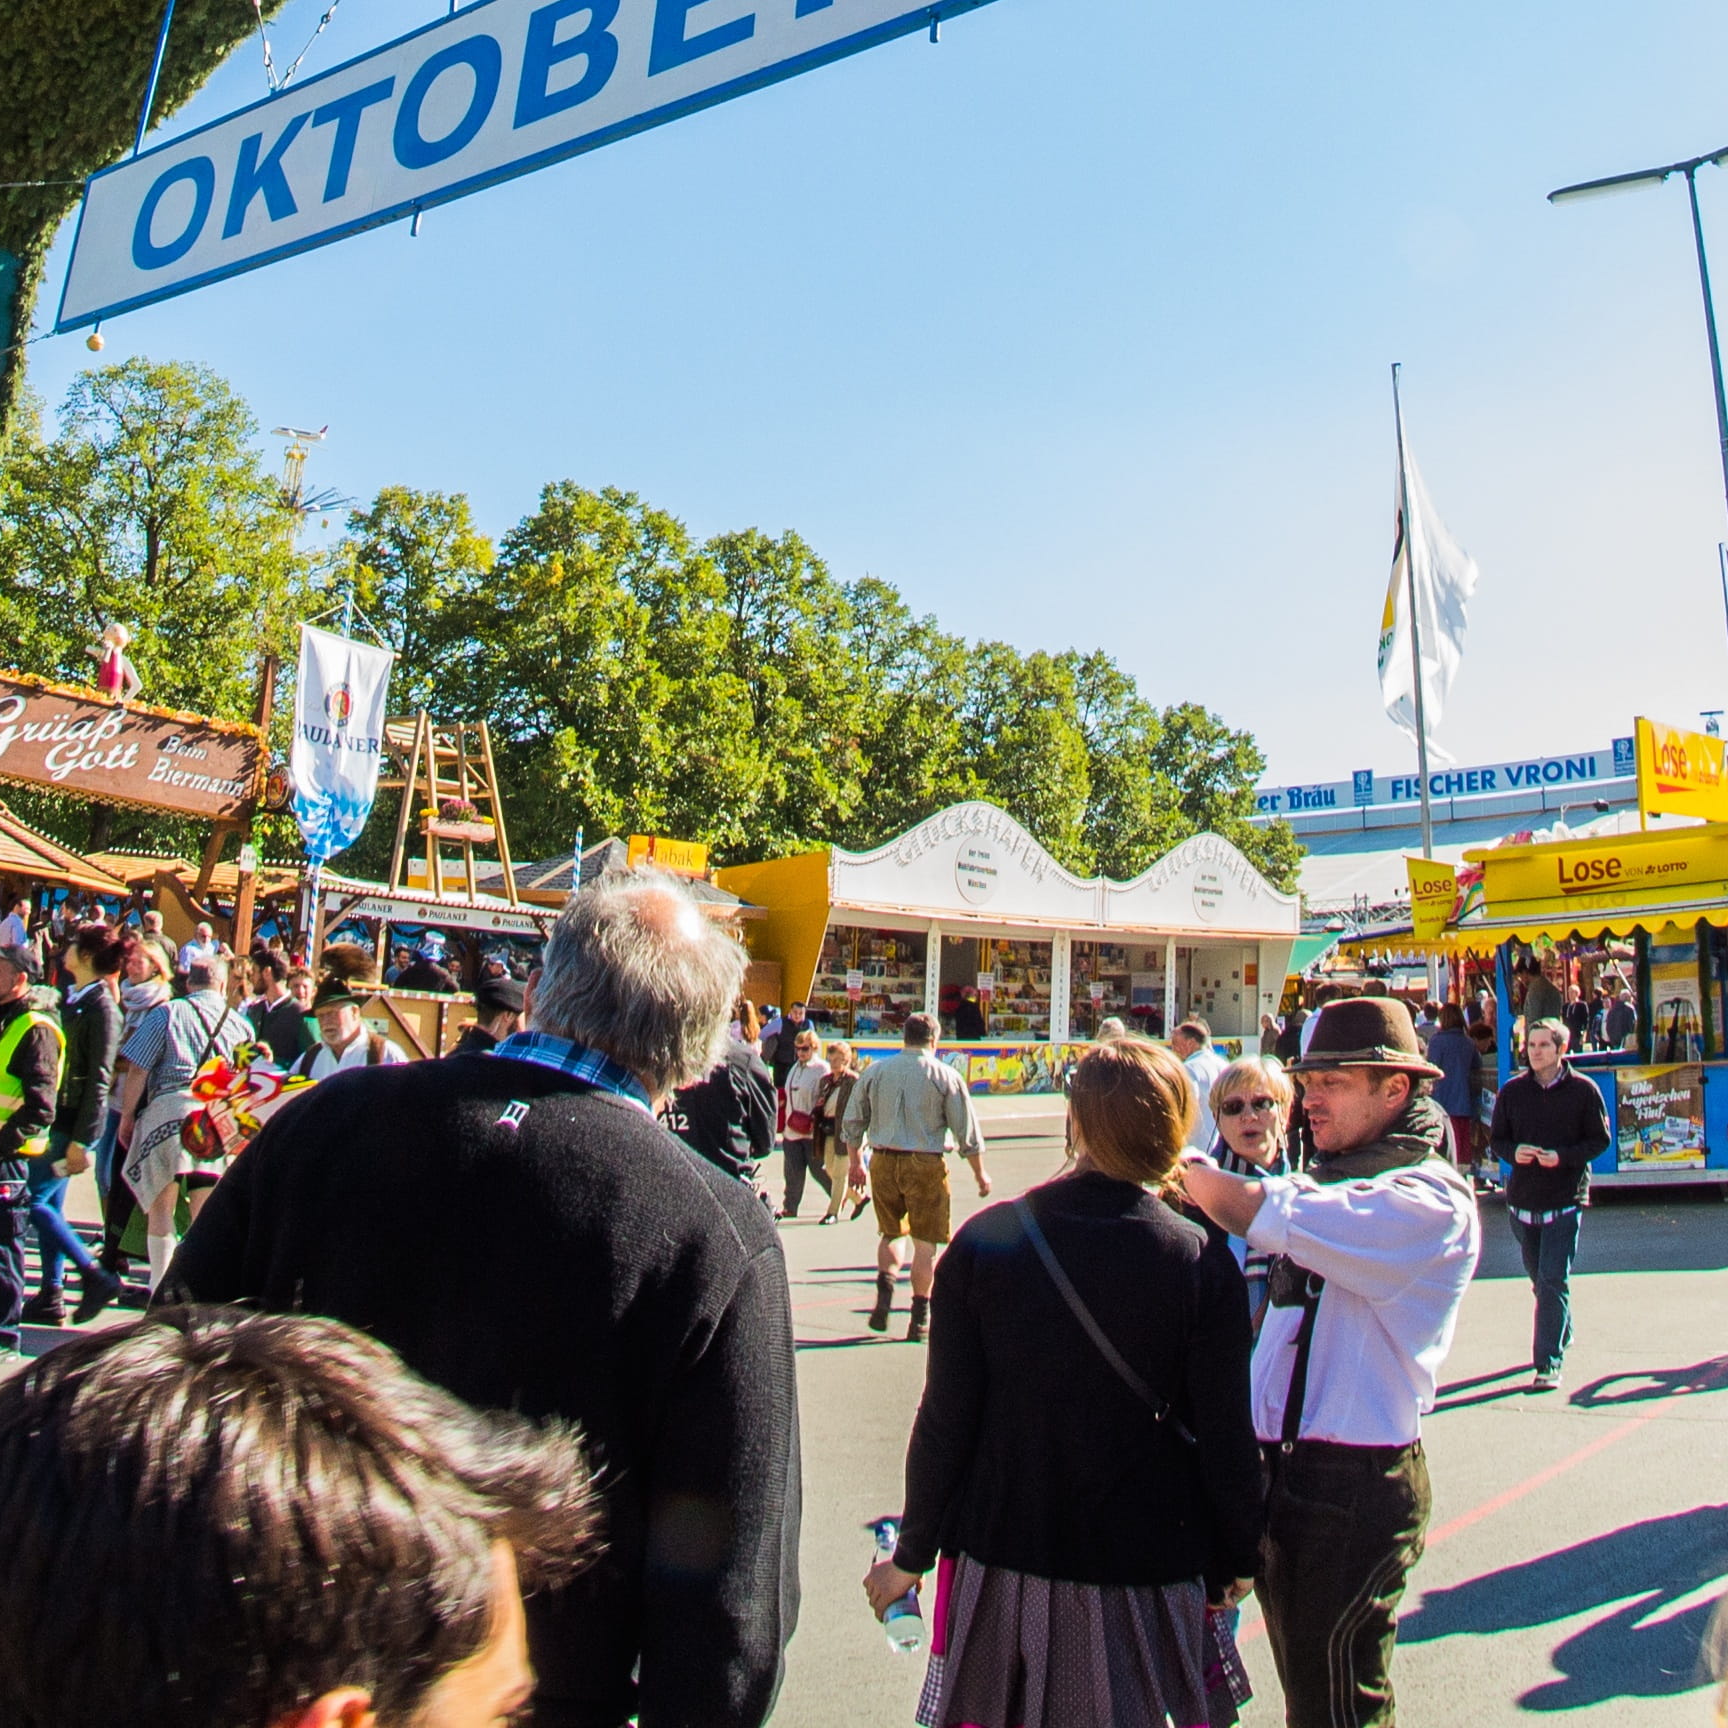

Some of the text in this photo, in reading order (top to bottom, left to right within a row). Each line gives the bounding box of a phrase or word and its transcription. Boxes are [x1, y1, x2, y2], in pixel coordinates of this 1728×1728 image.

[161, 735, 209, 761] Beim
[1651, 726, 1688, 781] Lose
[44, 740, 246, 798] Gott Biermann
[1286, 784, 1337, 812] Bräu
[1390, 767, 1497, 801] FISCHER
[1504, 756, 1597, 788] VRONI
[1557, 856, 1622, 885] Lose
[1656, 861, 1688, 874] LOTTO
[1412, 878, 1452, 895] Lose
[357, 901, 393, 914] AULANER
[428, 909, 468, 921] PAULANER
[658, 1113, 690, 1131] 412
